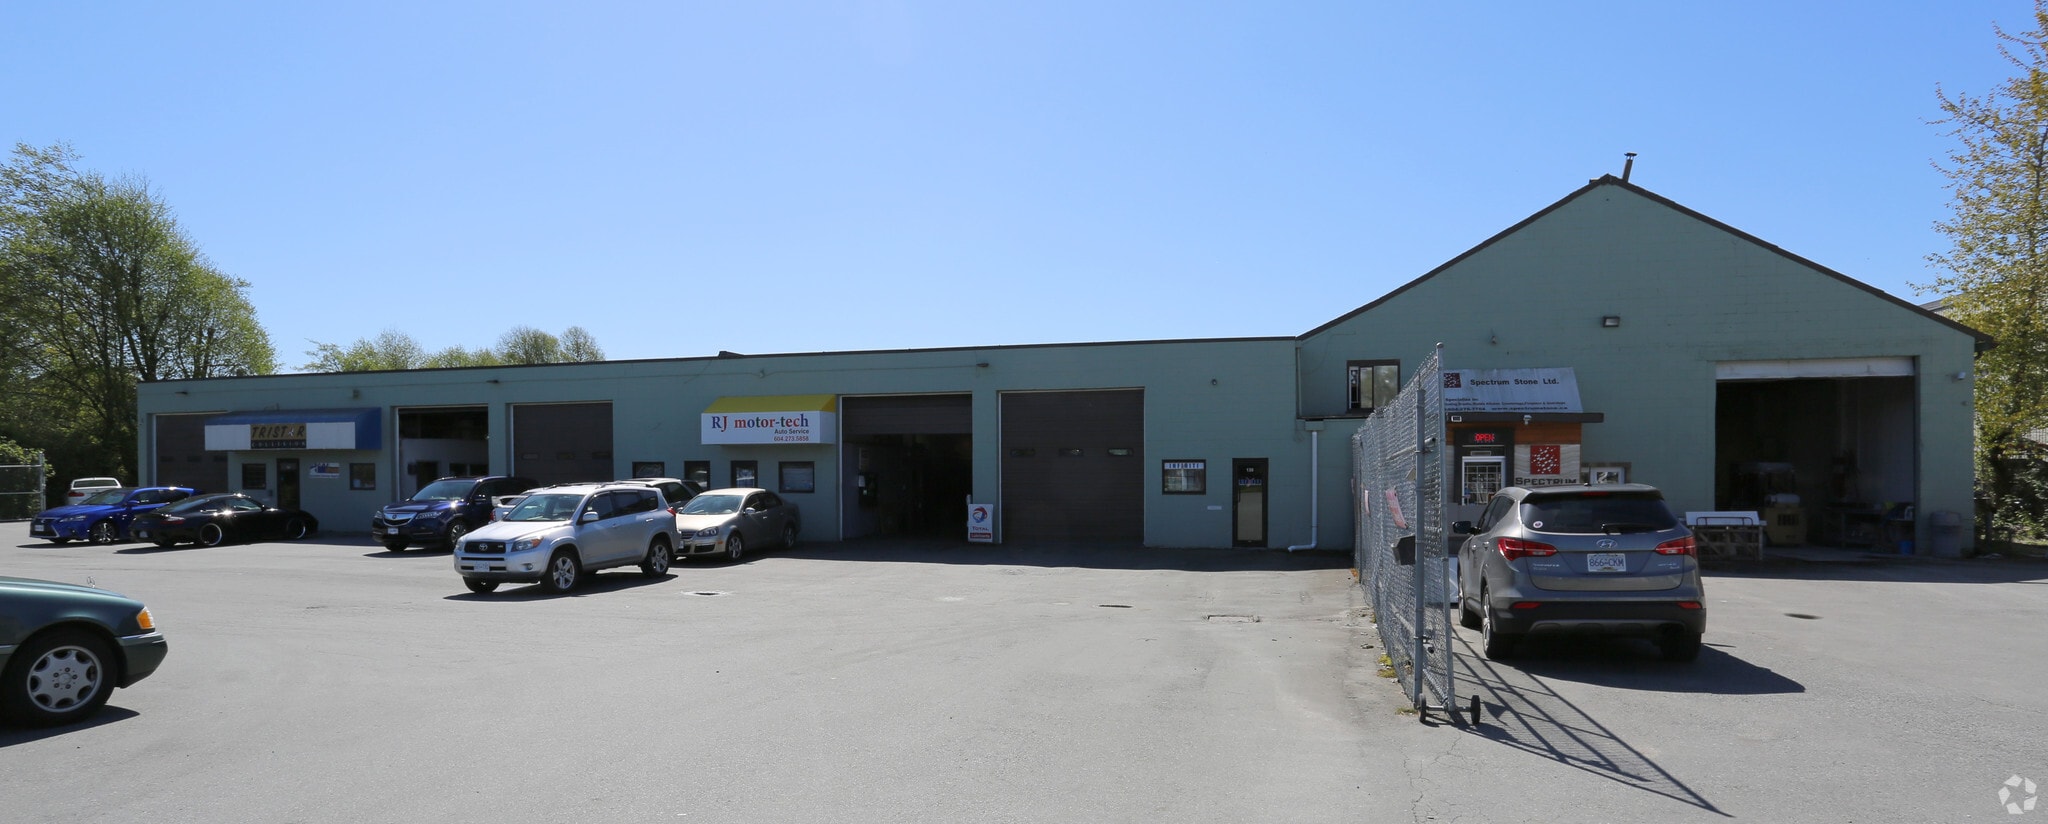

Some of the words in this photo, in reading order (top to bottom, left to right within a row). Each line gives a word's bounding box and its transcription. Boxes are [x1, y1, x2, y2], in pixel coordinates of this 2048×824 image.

[1470, 378, 1510, 387] Spectrum
[711, 416, 728, 432] RJ
[734, 413, 809, 429] motor-tech
[1475, 433, 1495, 441] OPEN
